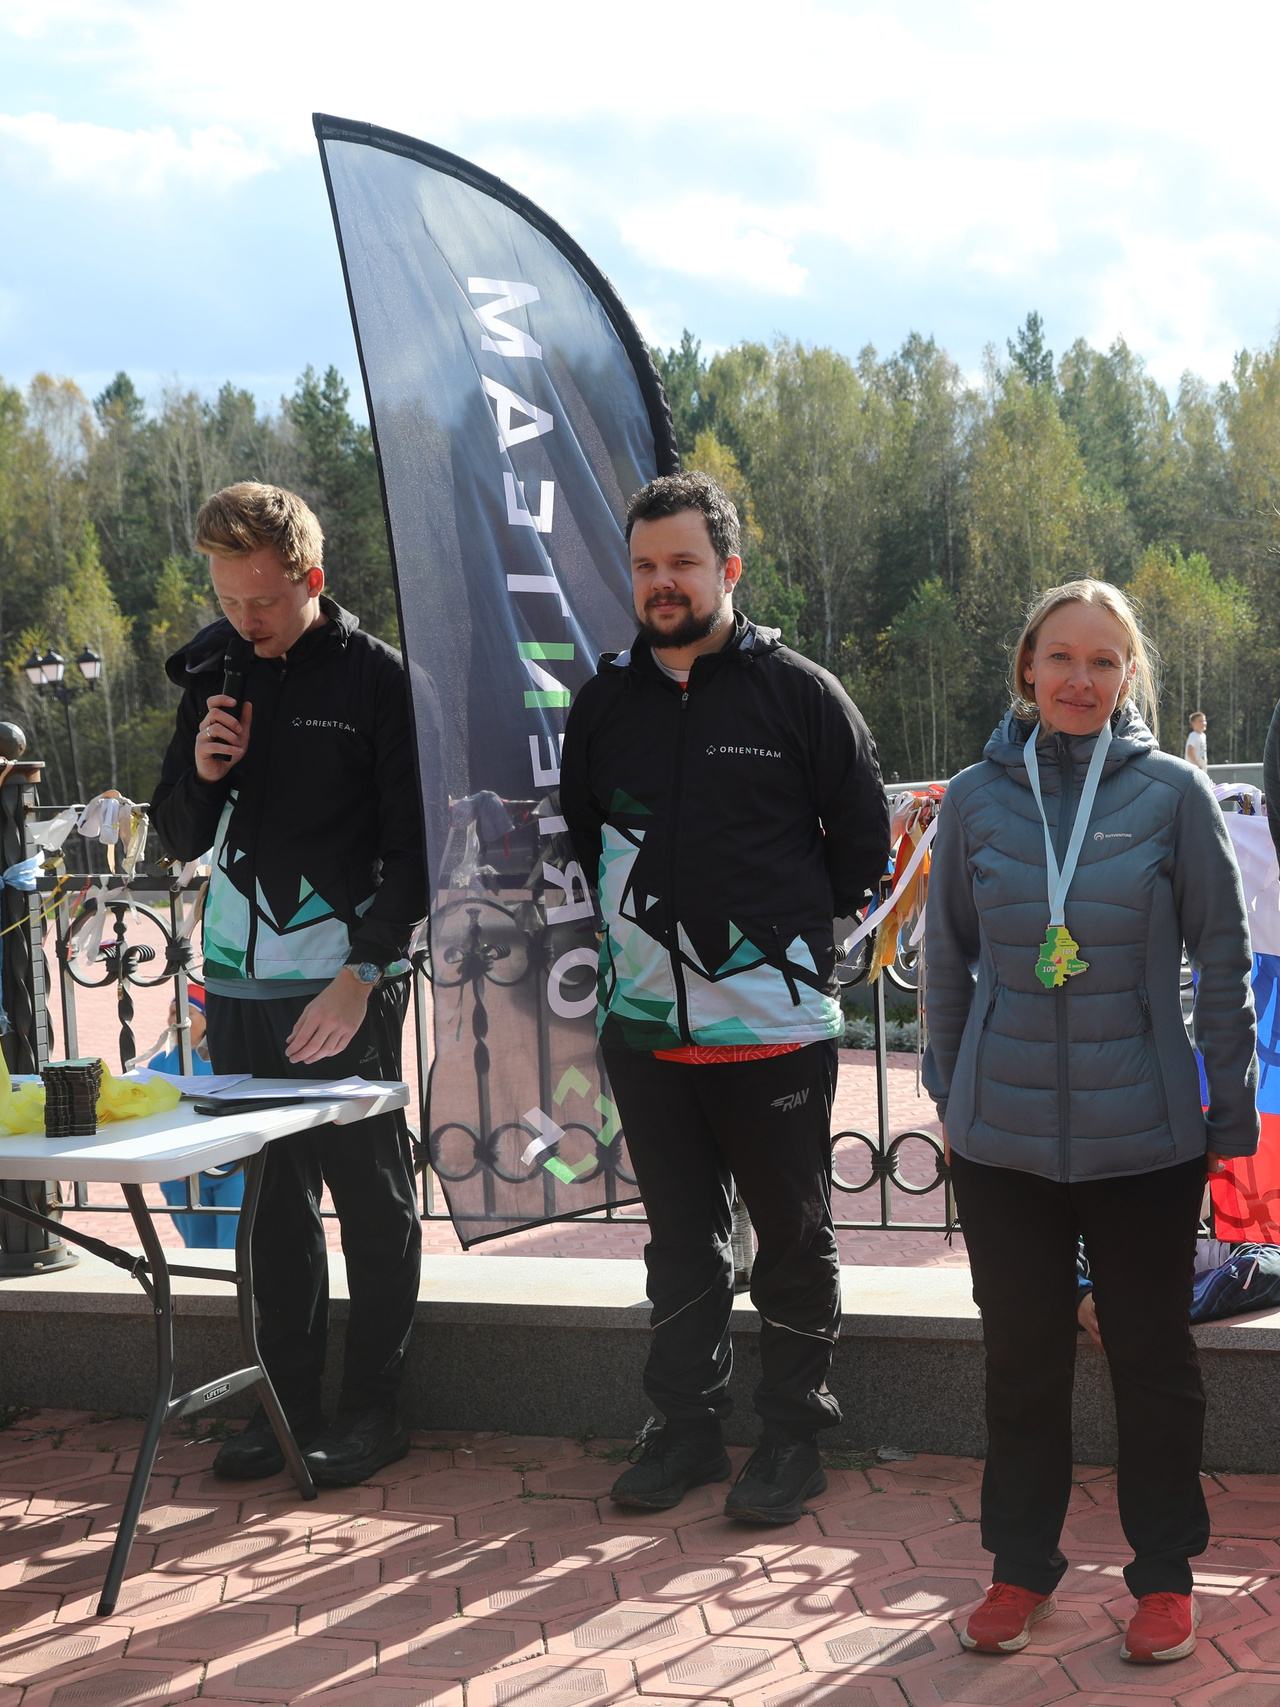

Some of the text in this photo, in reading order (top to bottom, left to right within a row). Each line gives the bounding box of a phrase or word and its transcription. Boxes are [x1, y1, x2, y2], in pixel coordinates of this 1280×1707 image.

[719, 745, 782, 759] ORIENTEAM
[1042, 965, 1056, 973] 101
[771, 1087, 810, 1112] RAY
